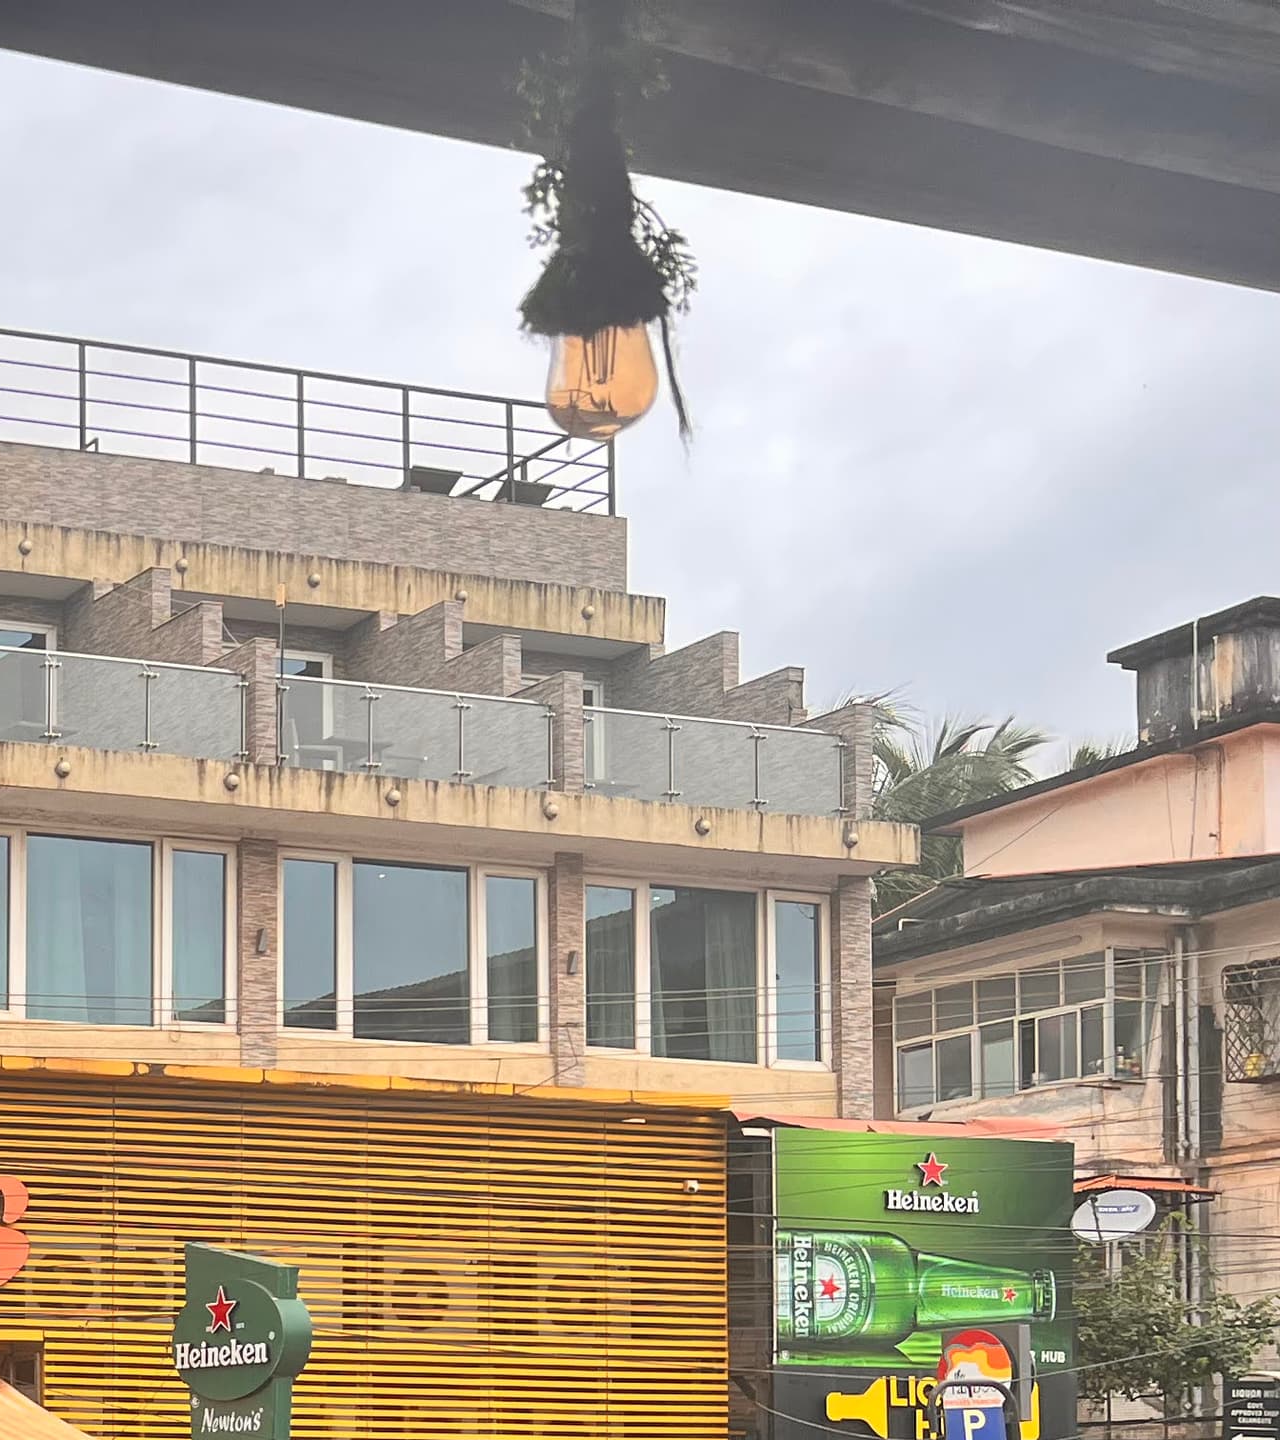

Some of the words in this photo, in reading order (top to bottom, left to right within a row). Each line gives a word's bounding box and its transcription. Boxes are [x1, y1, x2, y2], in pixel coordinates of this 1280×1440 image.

[887, 1189, 980, 1213] Heineken
[824, 1242, 860, 1288] HEINEKEN
[793, 1235, 813, 1338] Heineken
[941, 1284, 999, 1299] Heineken
[175, 1339, 268, 1369] Heineken
[1040, 1350, 1066, 1363] HUB
[201, 1407, 261, 1433] Newton's
[963, 1409, 986, 1440] P
